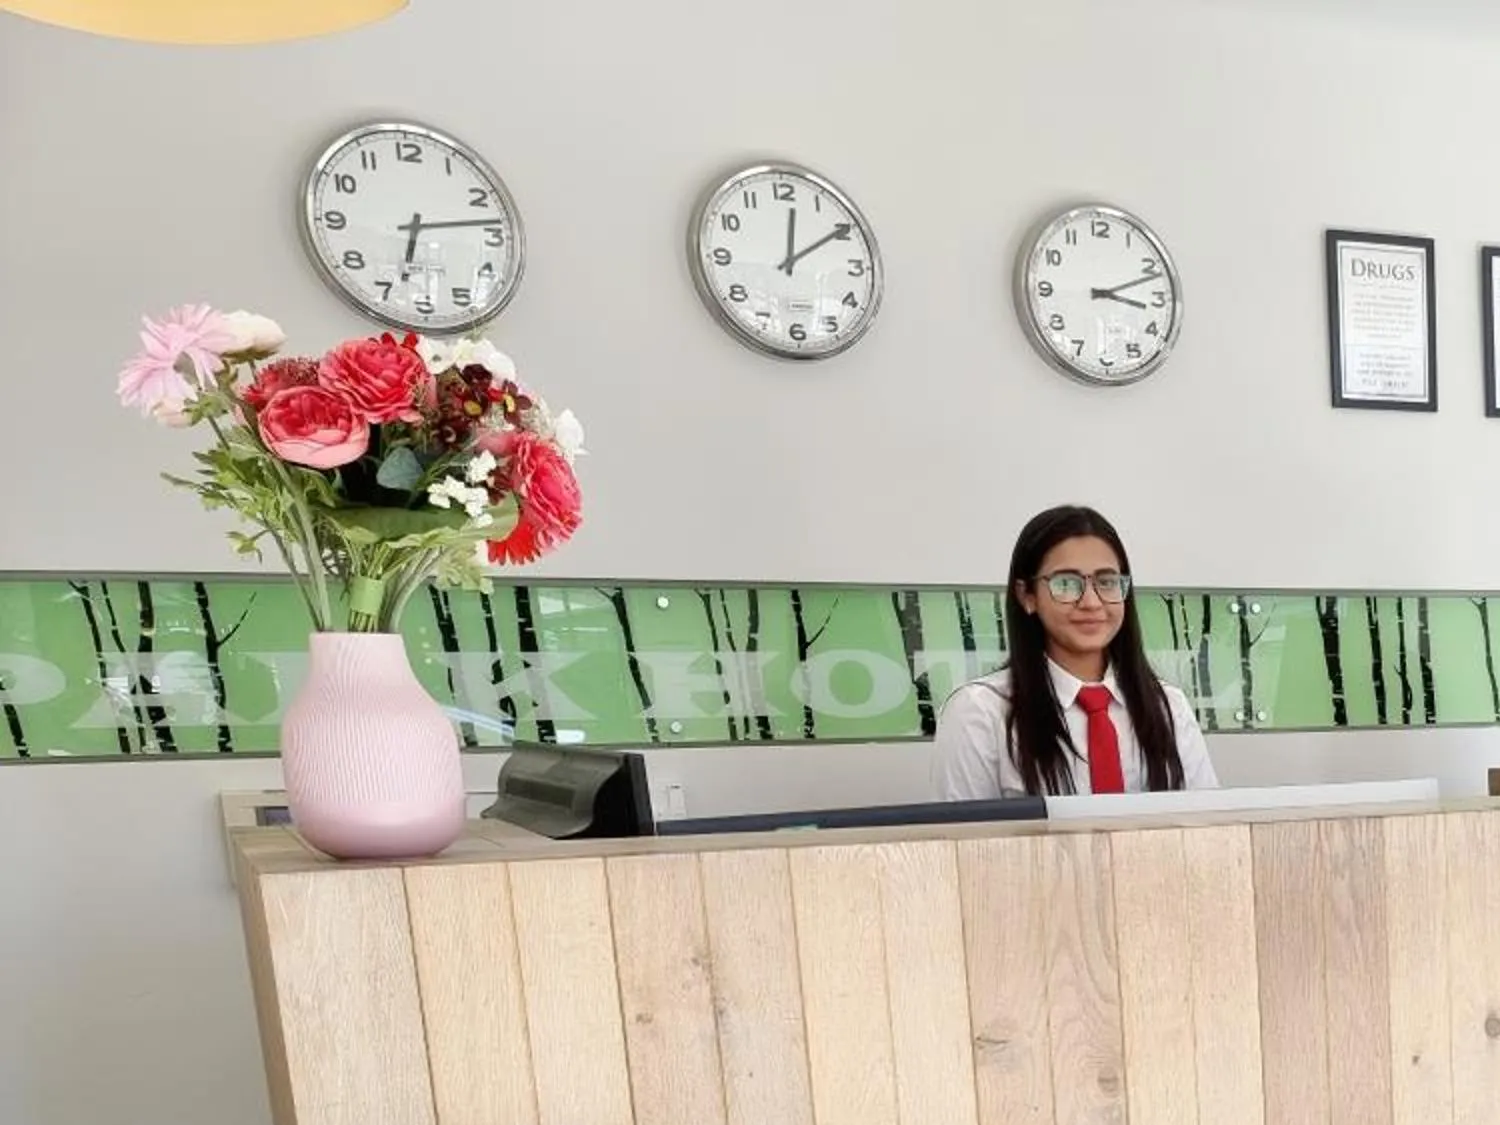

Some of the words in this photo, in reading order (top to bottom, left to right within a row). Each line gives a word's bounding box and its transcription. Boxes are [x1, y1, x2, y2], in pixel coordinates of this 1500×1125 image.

[361, 150, 377, 170] 11
[395, 142, 422, 163] 12
[335, 173, 357, 194] 10
[772, 182, 796, 202] 12
[468, 187, 489, 208] 2
[744, 191, 758, 209] 11
[324, 210, 347, 230] 9
[721, 213, 740, 231] 10
[484, 227, 505, 247] 3
[1065, 229, 1077, 245] 11
[1091, 220, 1110, 239] 12
[342, 250, 365, 270] 8
[713, 248, 732, 266] 9
[1045, 249, 1061, 266] 10
[1141, 258, 1157, 274] 2
[847, 259, 864, 277] 3
[1350, 257, 1416, 281] DRUGS
[374, 281, 393, 301] 7
[452, 287, 471, 306] 5
[729, 284, 748, 303] 8
[1037, 281, 1053, 297] 9
[841, 291, 859, 309] 4
[1151, 291, 1166, 308] 3
[822, 315, 839, 333] 5
[1050, 314, 1065, 331] 8
[1145, 321, 1159, 337] 4
[789, 323, 807, 341] 6
[1071, 339, 1085, 356] 7
[1126, 343, 1142, 359] 5
[0, 651, 600, 728] AK
[632, 648, 1247, 720] HOTL
